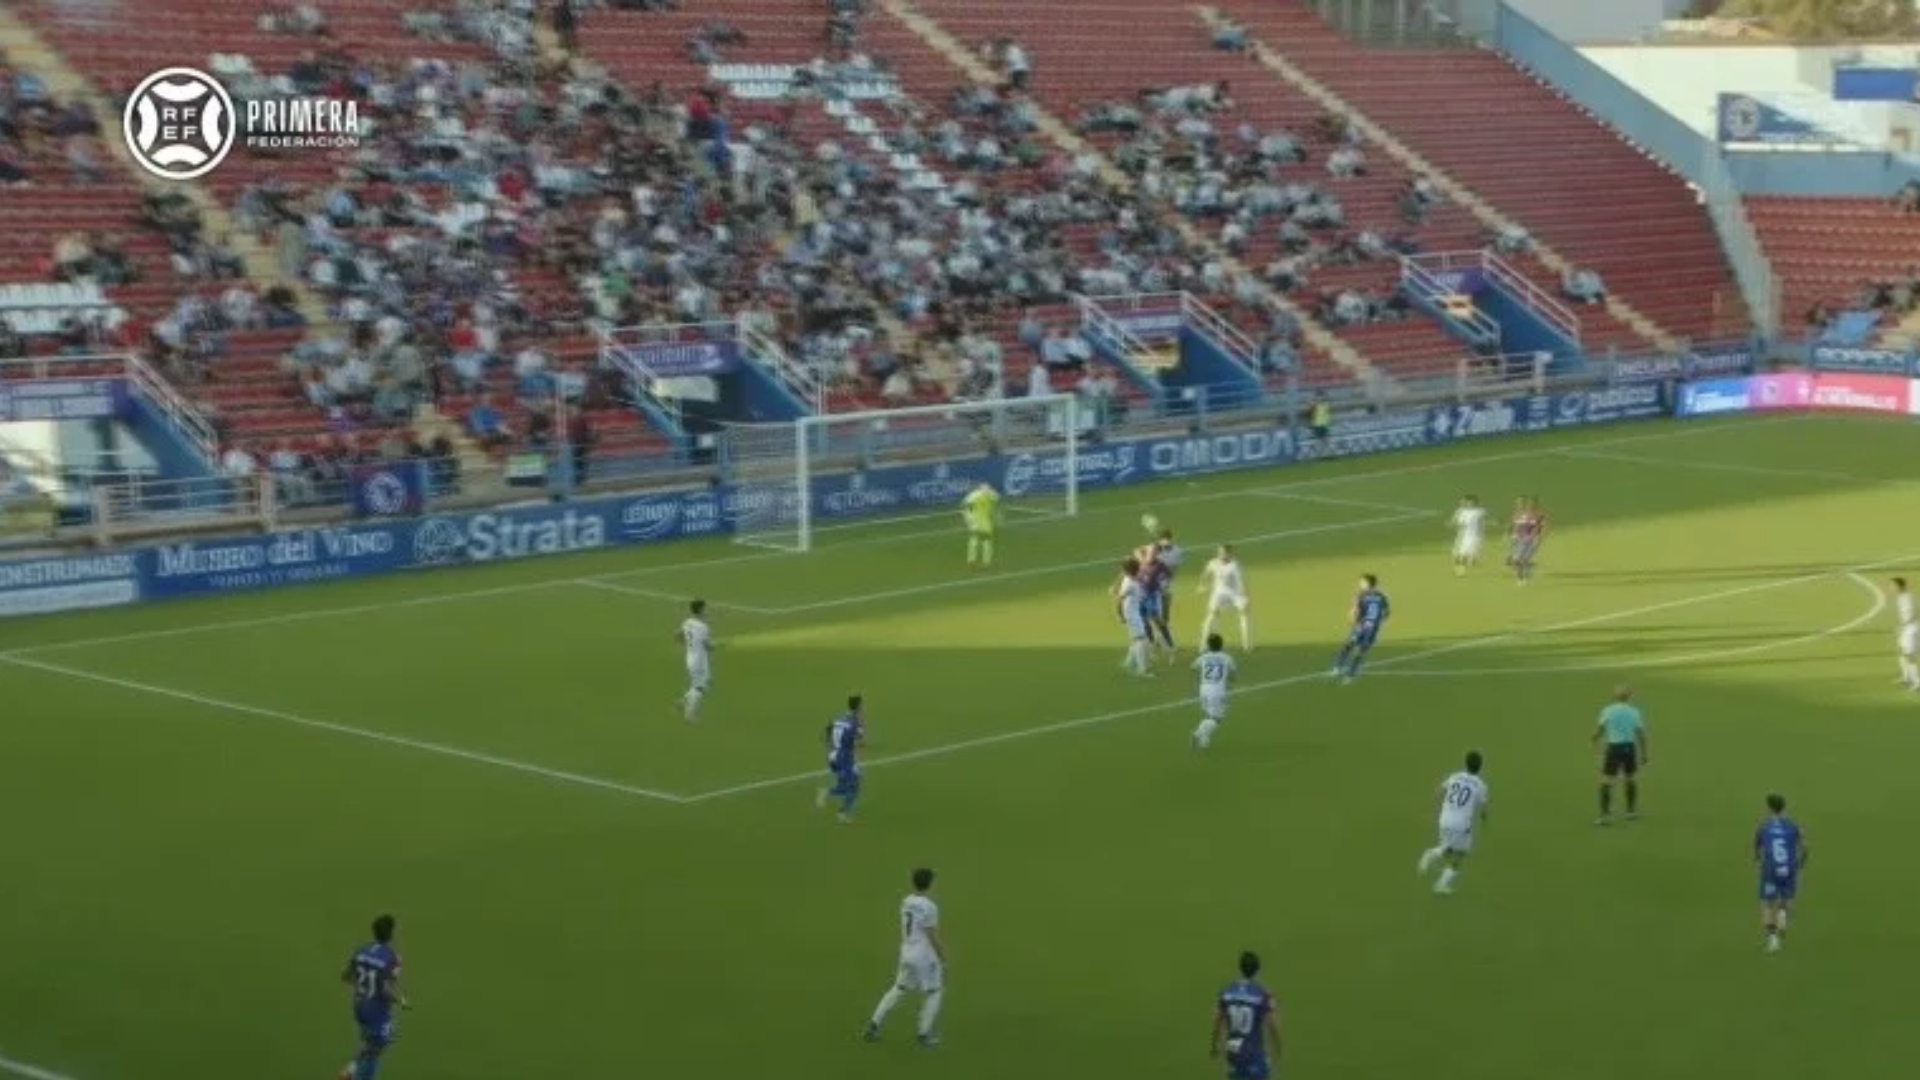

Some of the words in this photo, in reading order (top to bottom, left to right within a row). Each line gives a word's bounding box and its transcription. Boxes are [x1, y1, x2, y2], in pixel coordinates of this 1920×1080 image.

[268, 529, 316, 565] del
[466, 509, 605, 561] Strata
[1449, 781, 1472, 807] 20
[1771, 837, 1789, 864] 6
[355, 966, 378, 999] 21
[1228, 1003, 1254, 1035] 10
